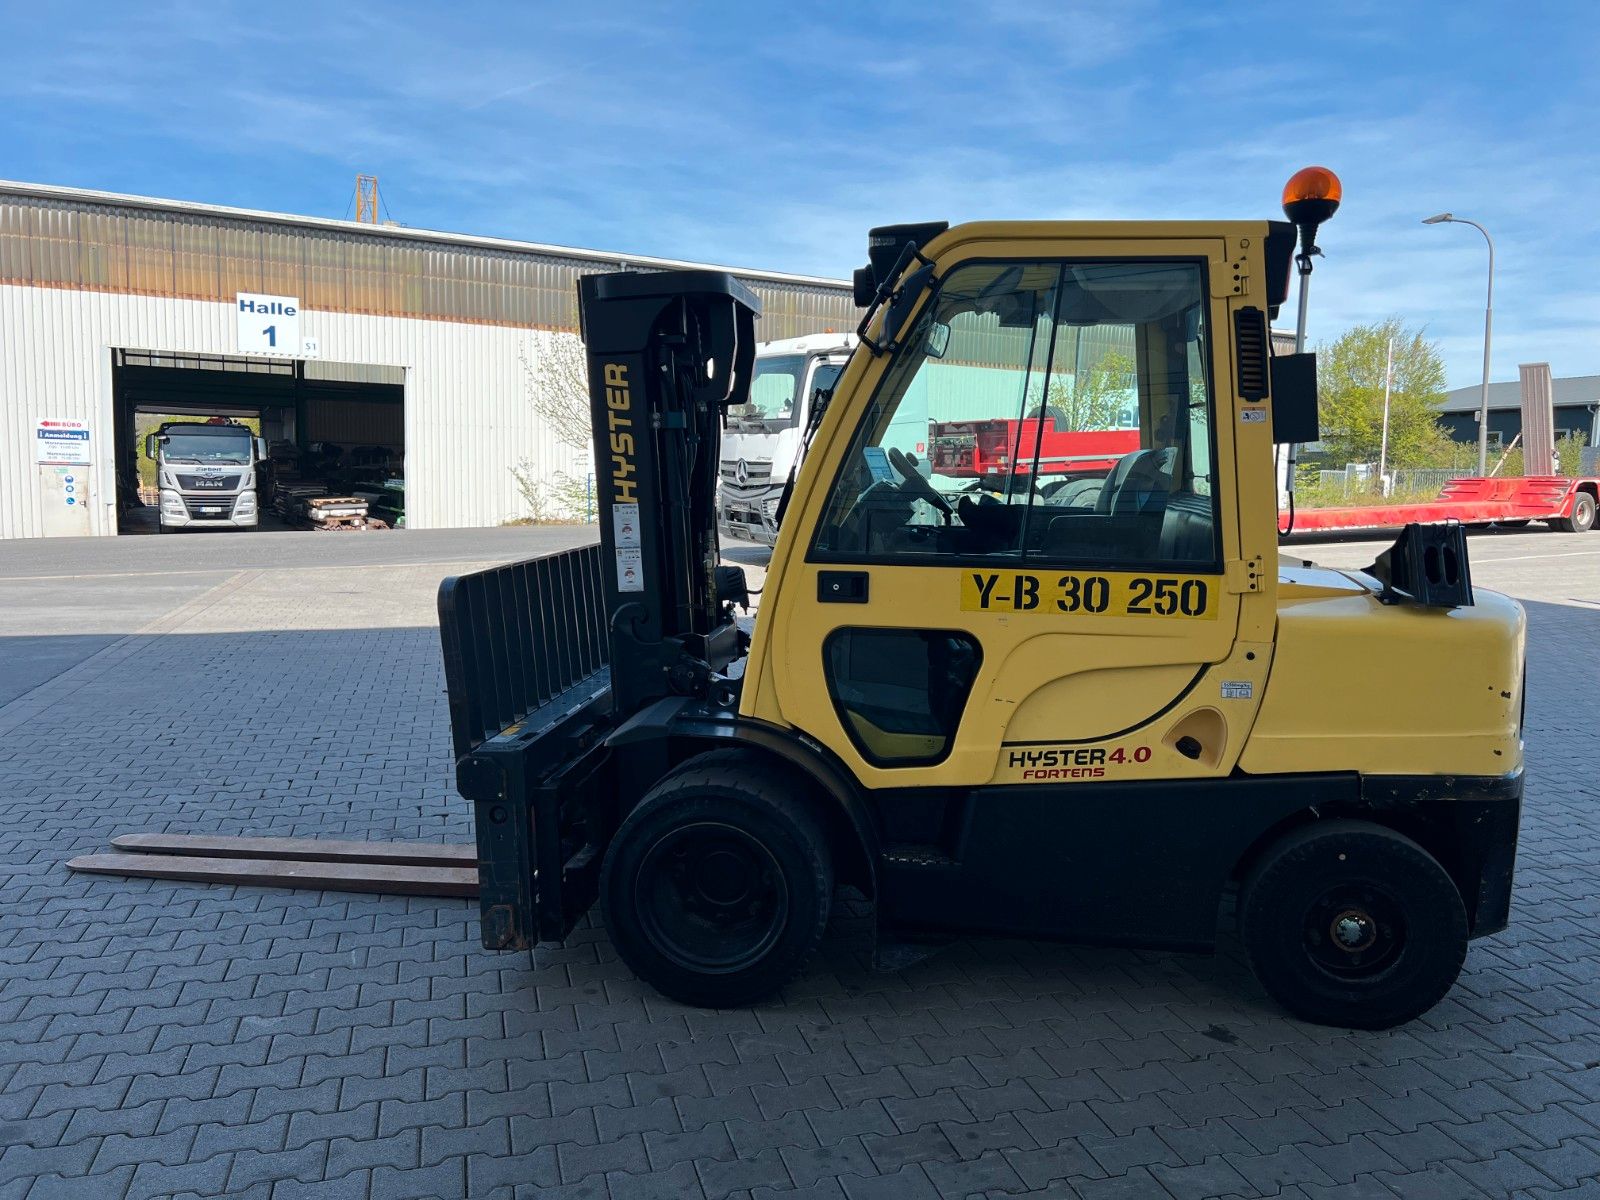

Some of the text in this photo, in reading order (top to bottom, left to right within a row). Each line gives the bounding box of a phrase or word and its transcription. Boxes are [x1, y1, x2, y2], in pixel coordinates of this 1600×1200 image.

[239, 299, 297, 316] Halle
[262, 325, 276, 347] 1
[604, 363, 638, 504] HYSTER
[973, 573, 1208, 616] Y-B 30 250
[1009, 746, 1152, 768] HYSTER 4.0
[1022, 767, 1105, 780] FORTENS
